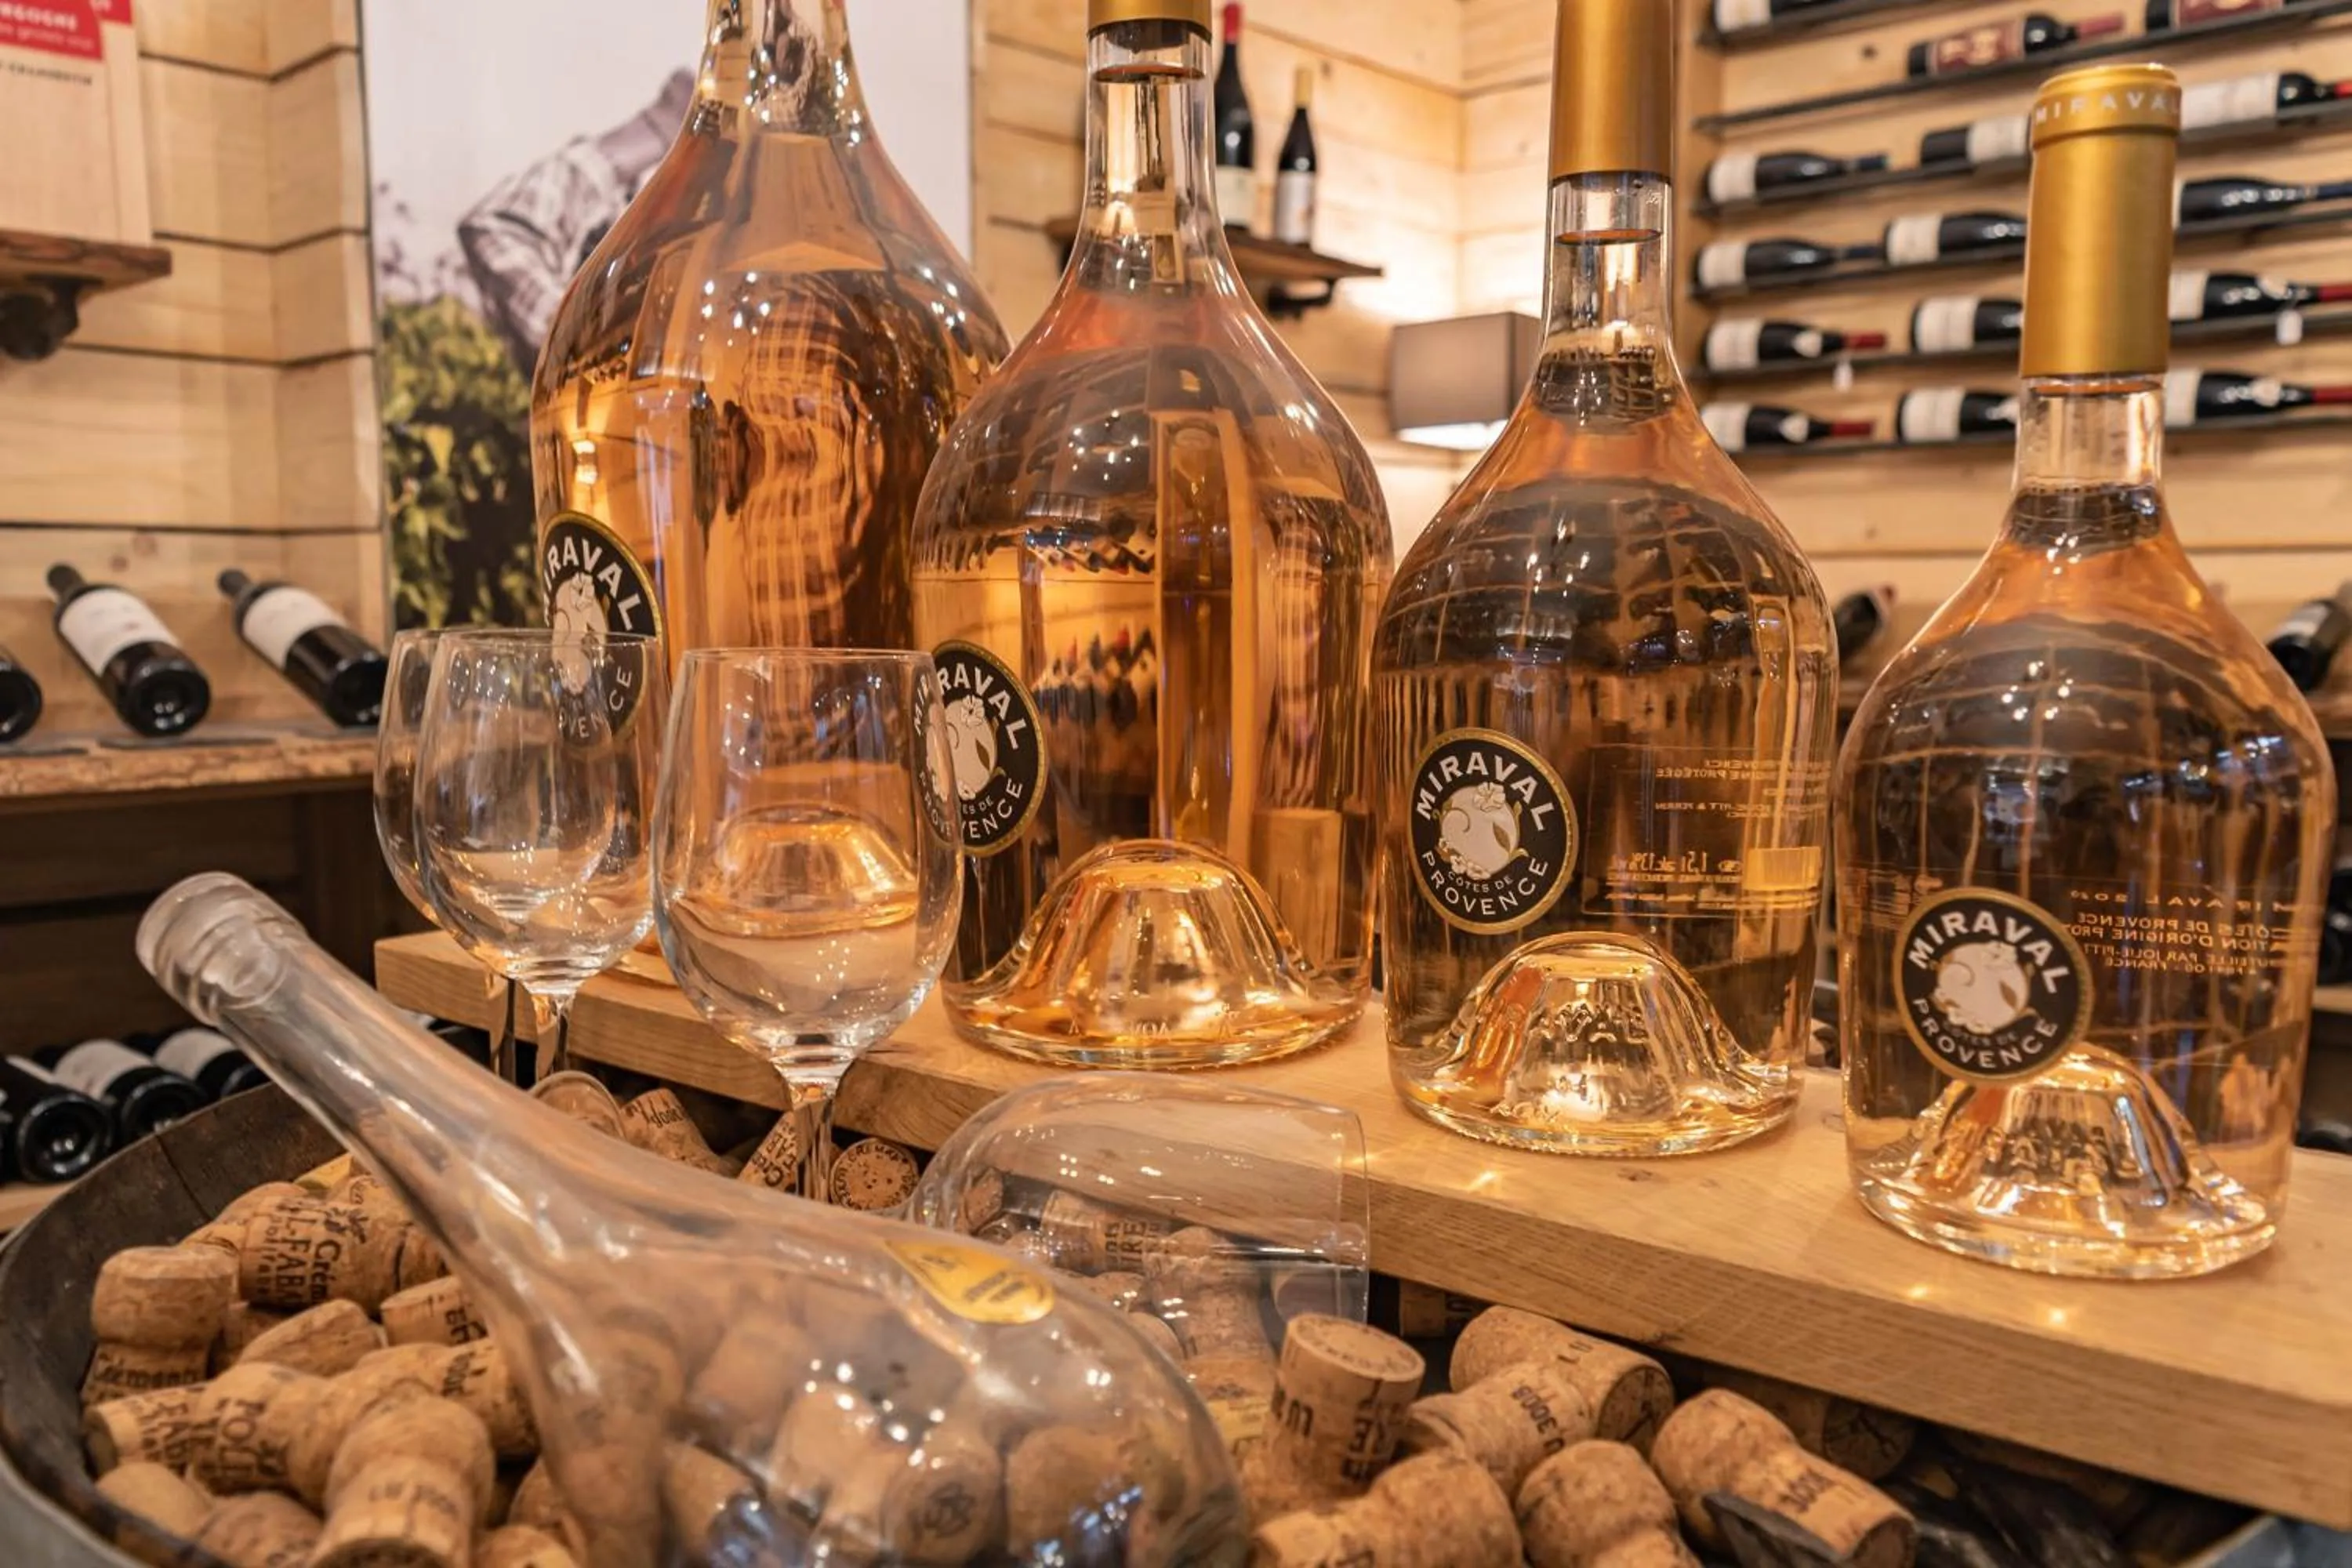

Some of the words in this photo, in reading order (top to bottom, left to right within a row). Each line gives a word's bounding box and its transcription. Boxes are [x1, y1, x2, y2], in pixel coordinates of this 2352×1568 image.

[1417, 752, 1555, 831] MIRAVAL
[1422, 851, 1548, 915] PROVENCE
[1494, 875, 1514, 891] DE
[1907, 911, 2070, 993] MIRAVAL
[1913, 999, 2058, 1068] PROVENCE
